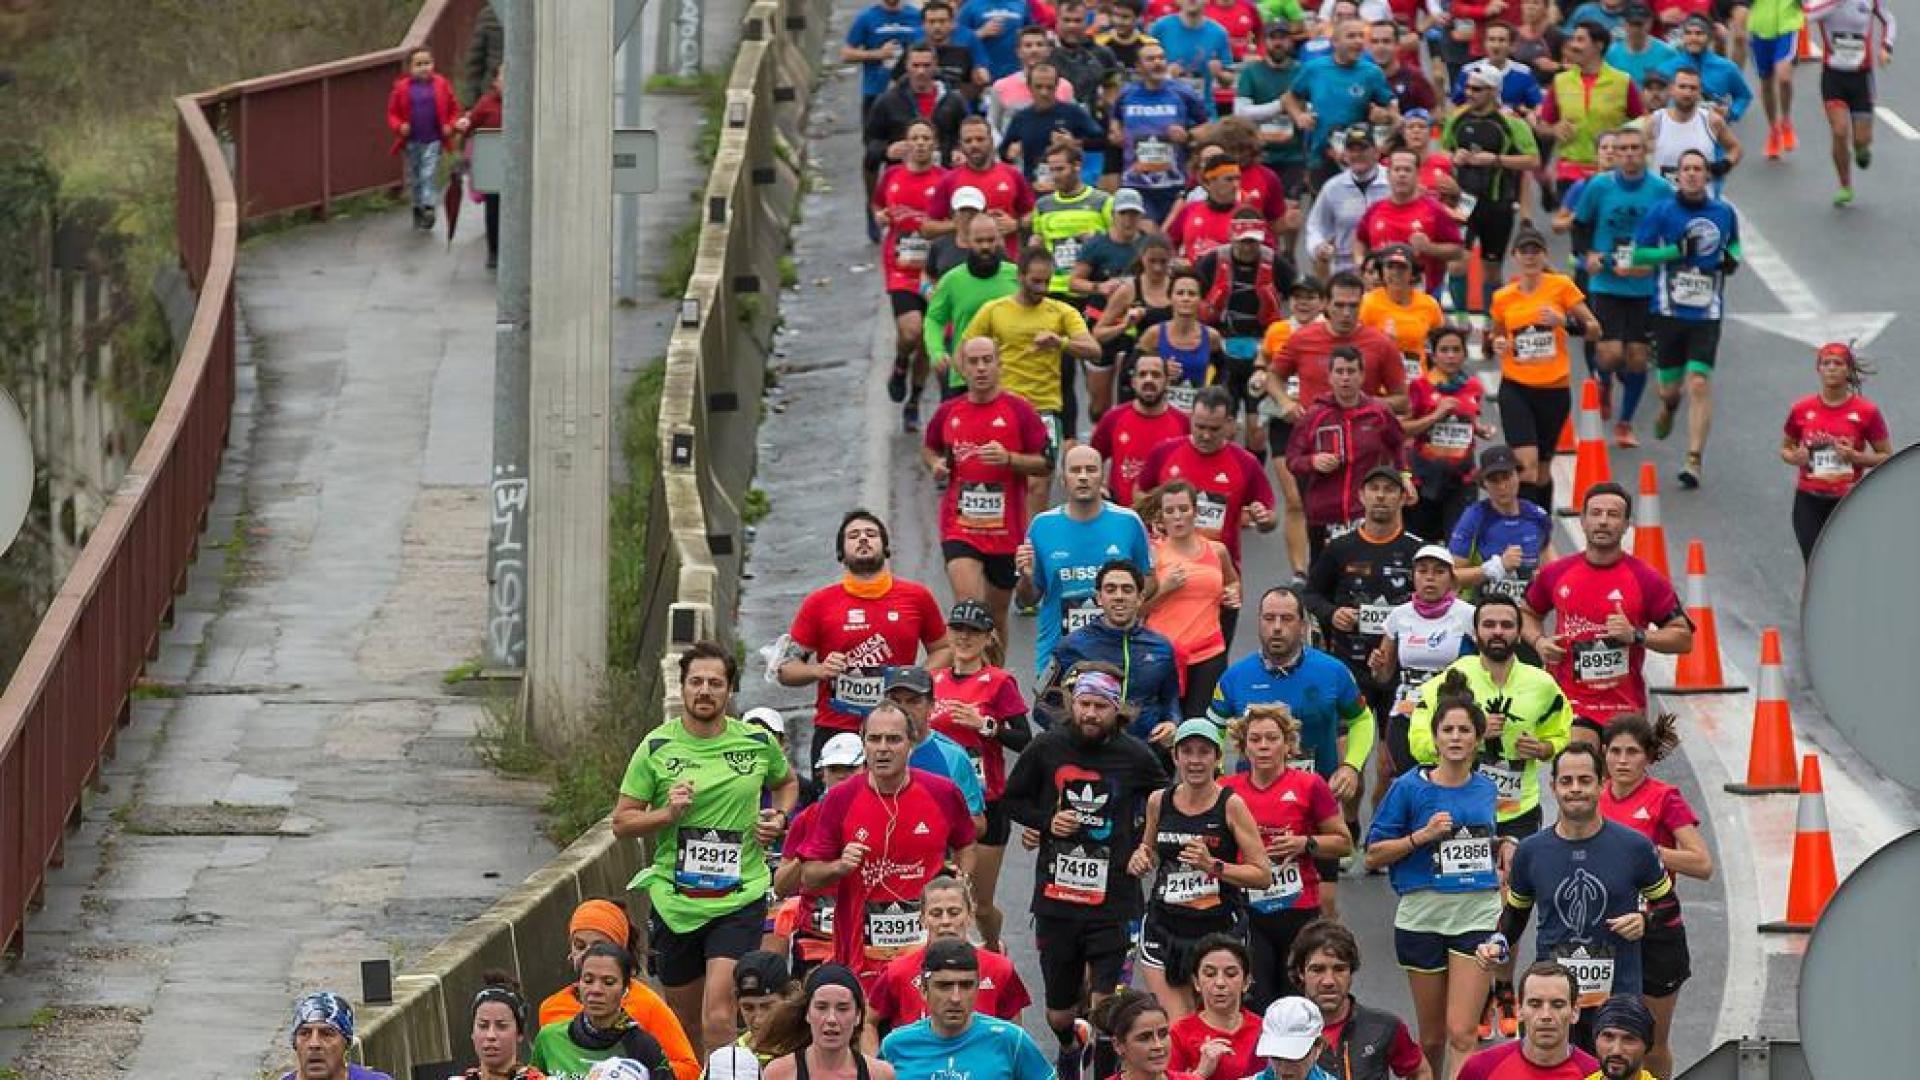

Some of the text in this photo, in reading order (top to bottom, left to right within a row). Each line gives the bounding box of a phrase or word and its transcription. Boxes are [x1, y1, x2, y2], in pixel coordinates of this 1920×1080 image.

[965, 496, 1001, 509] 21215
[1060, 566, 1102, 580] BISS
[1582, 651, 1622, 668] 8952
[839, 680, 881, 696] 17001
[689, 846, 738, 864] 12912
[1060, 859, 1098, 878] 7418
